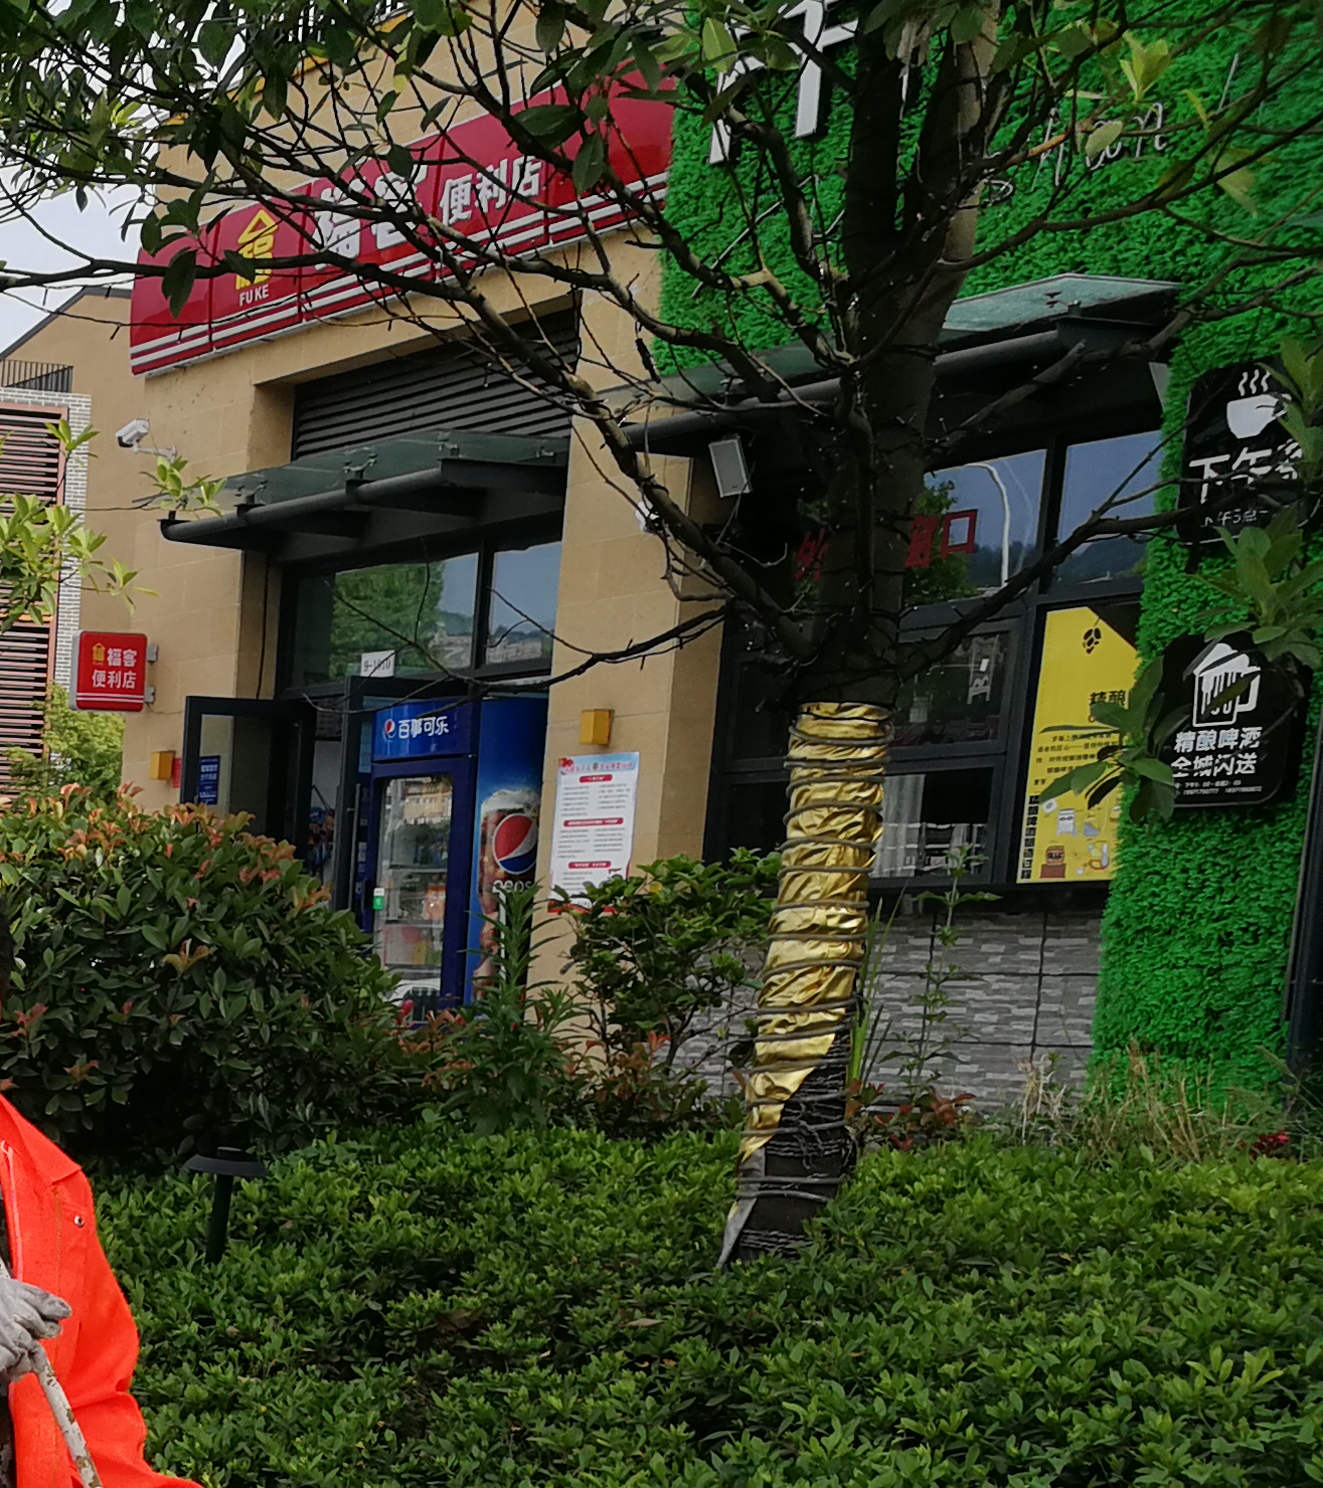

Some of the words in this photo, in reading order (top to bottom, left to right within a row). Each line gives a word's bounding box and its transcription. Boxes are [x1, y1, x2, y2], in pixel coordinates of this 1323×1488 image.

[440, 156, 542, 226] 便利店
[107, 648, 138, 668] 福客
[91, 669, 138, 690] 便利店
[398, 716, 450, 739] 百事可乐
[1174, 727, 1263, 753] 精酿啤酒
[1170, 752, 1258, 778] 全城闪送
